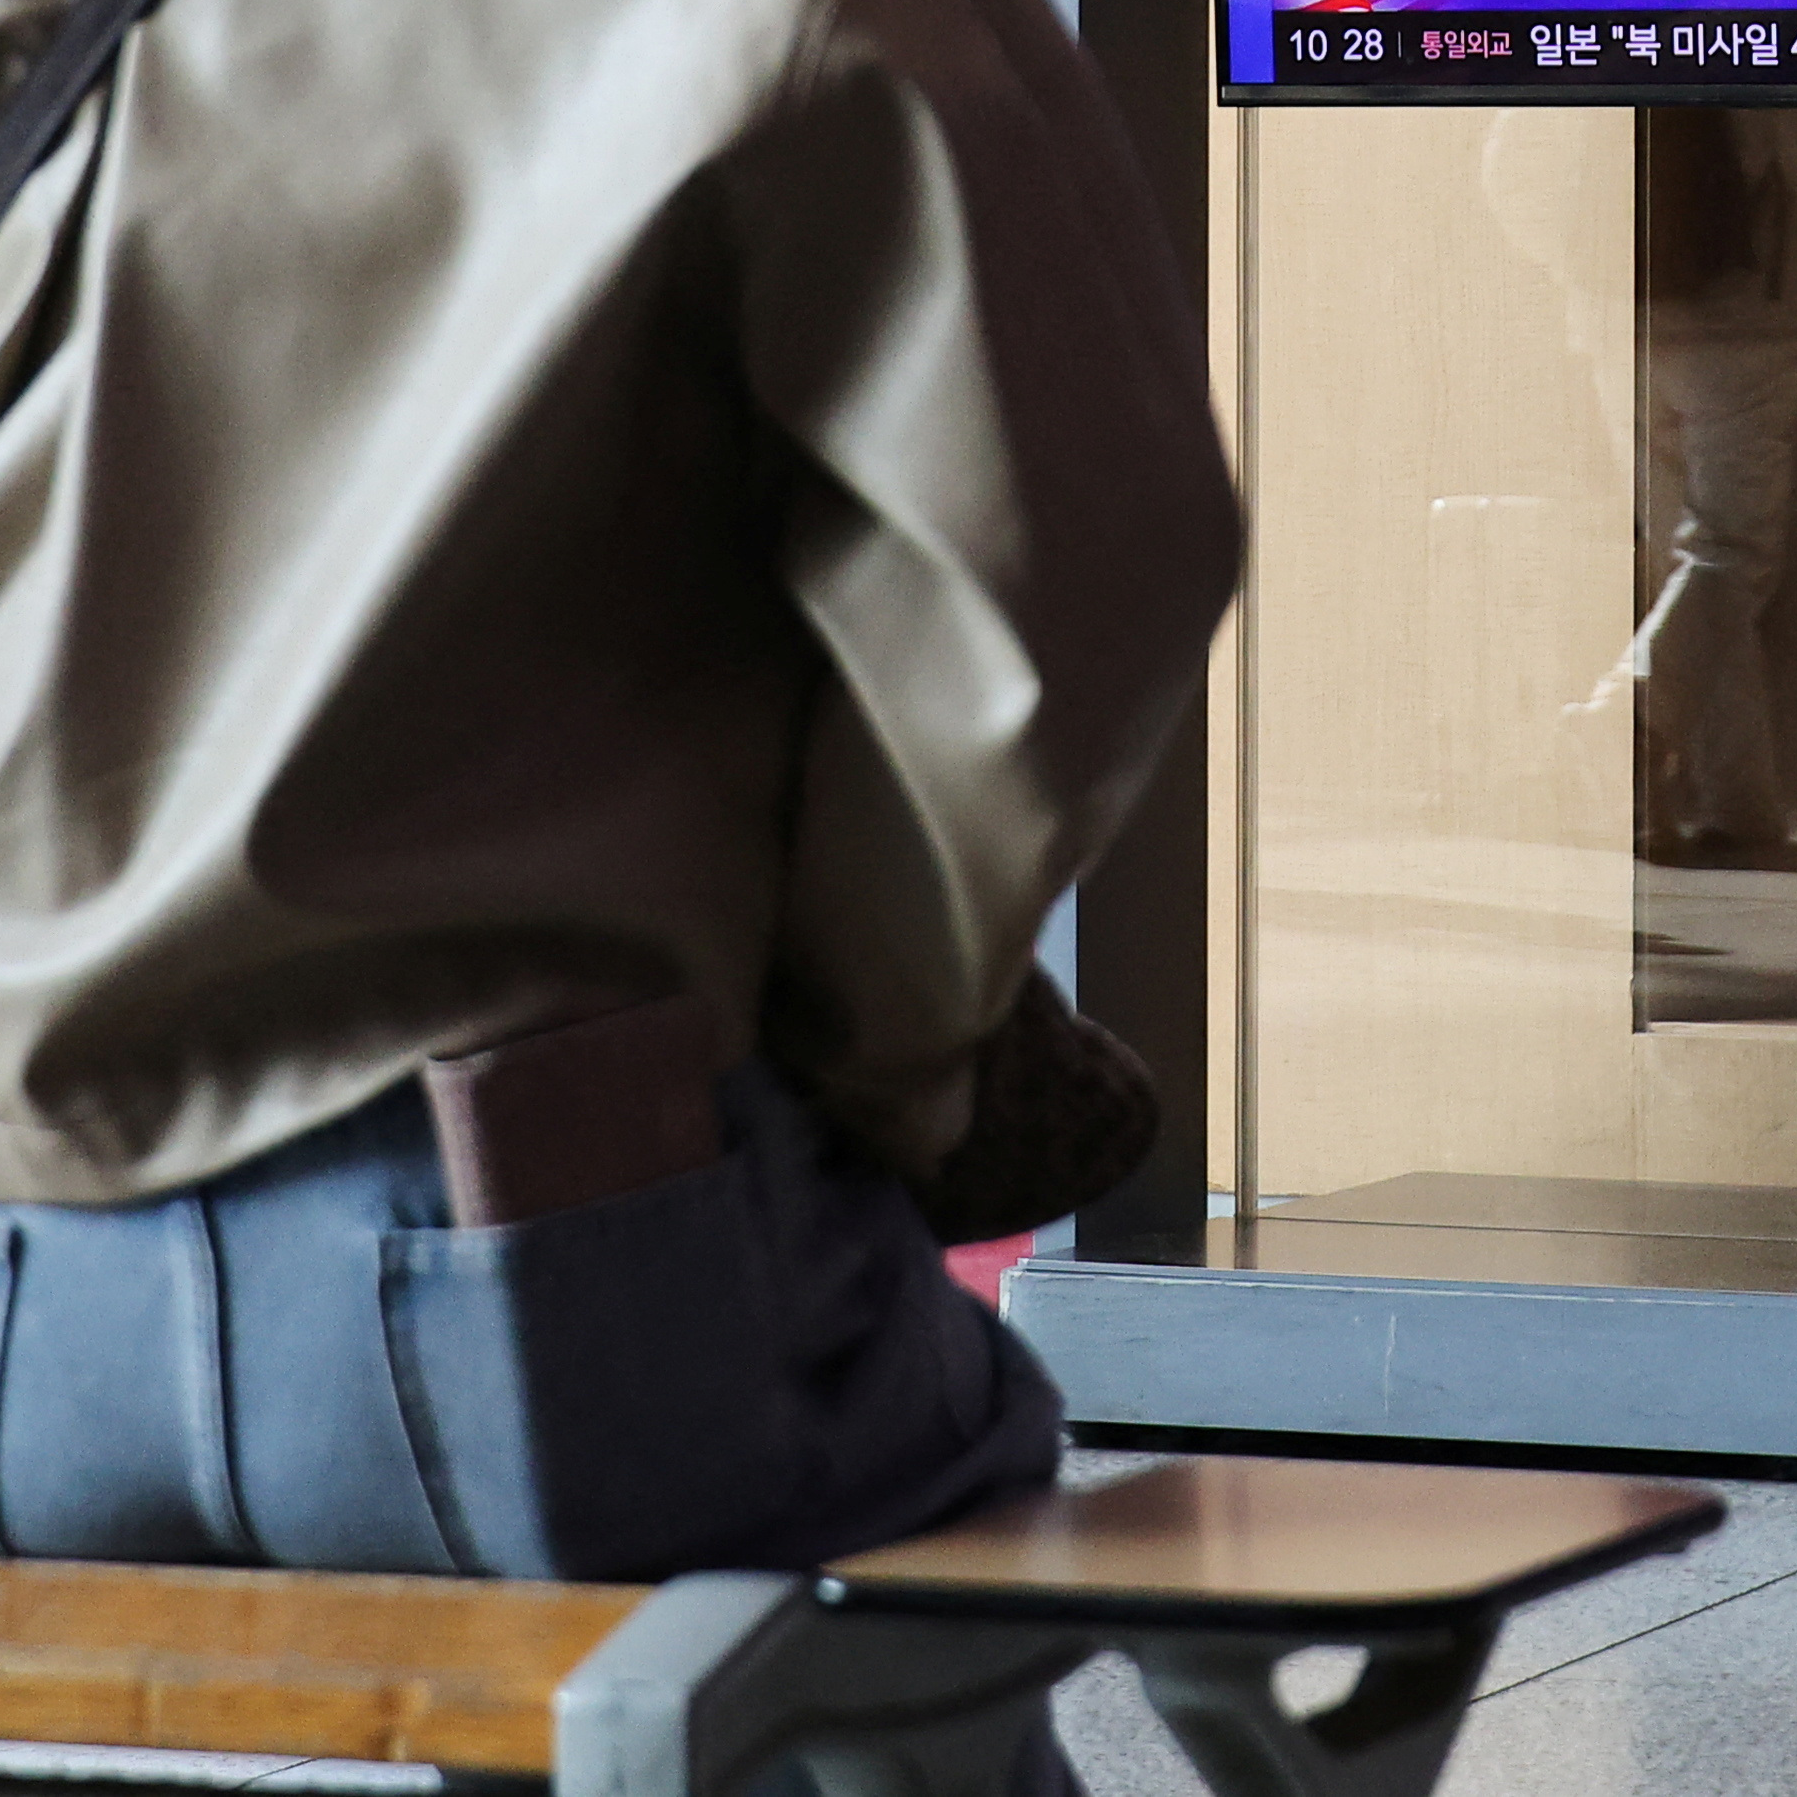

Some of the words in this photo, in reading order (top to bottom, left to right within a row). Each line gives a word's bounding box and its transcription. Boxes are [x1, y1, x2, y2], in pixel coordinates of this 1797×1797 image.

[1288, 29, 1328, 61] 10
[1343, 29, 1384, 61] 28
[1420, 30, 1513, 61] 통일외교
[1529, 23, 1601, 66] 일본
[1611, 24, 1661, 66] "북
[1673, 23, 1780, 66] 미사일
